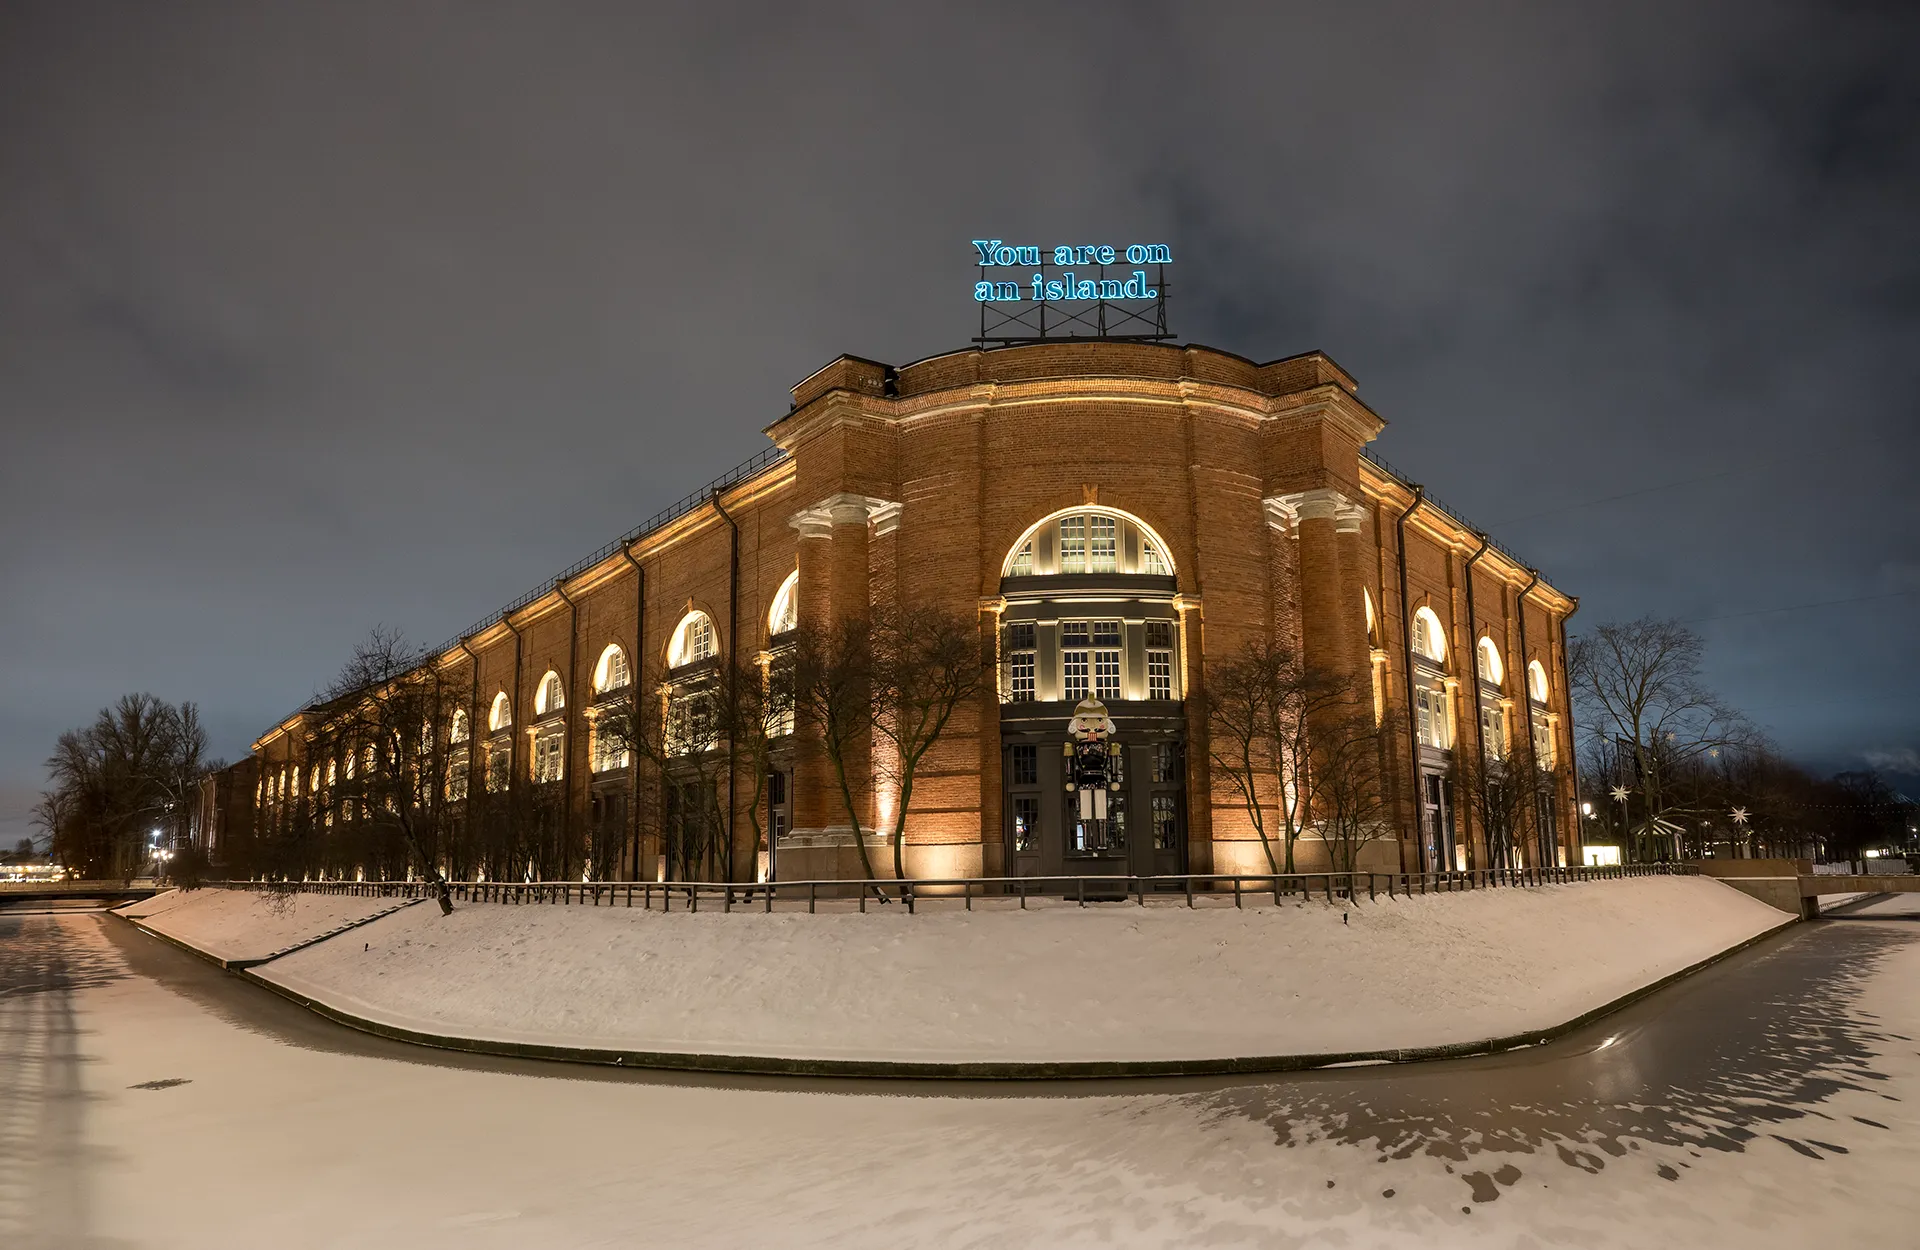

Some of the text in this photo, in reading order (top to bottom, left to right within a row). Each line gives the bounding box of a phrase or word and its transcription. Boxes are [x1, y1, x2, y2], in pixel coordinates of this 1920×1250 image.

[972, 239, 1173, 266] You are on
[974, 270, 1158, 301] an island.
